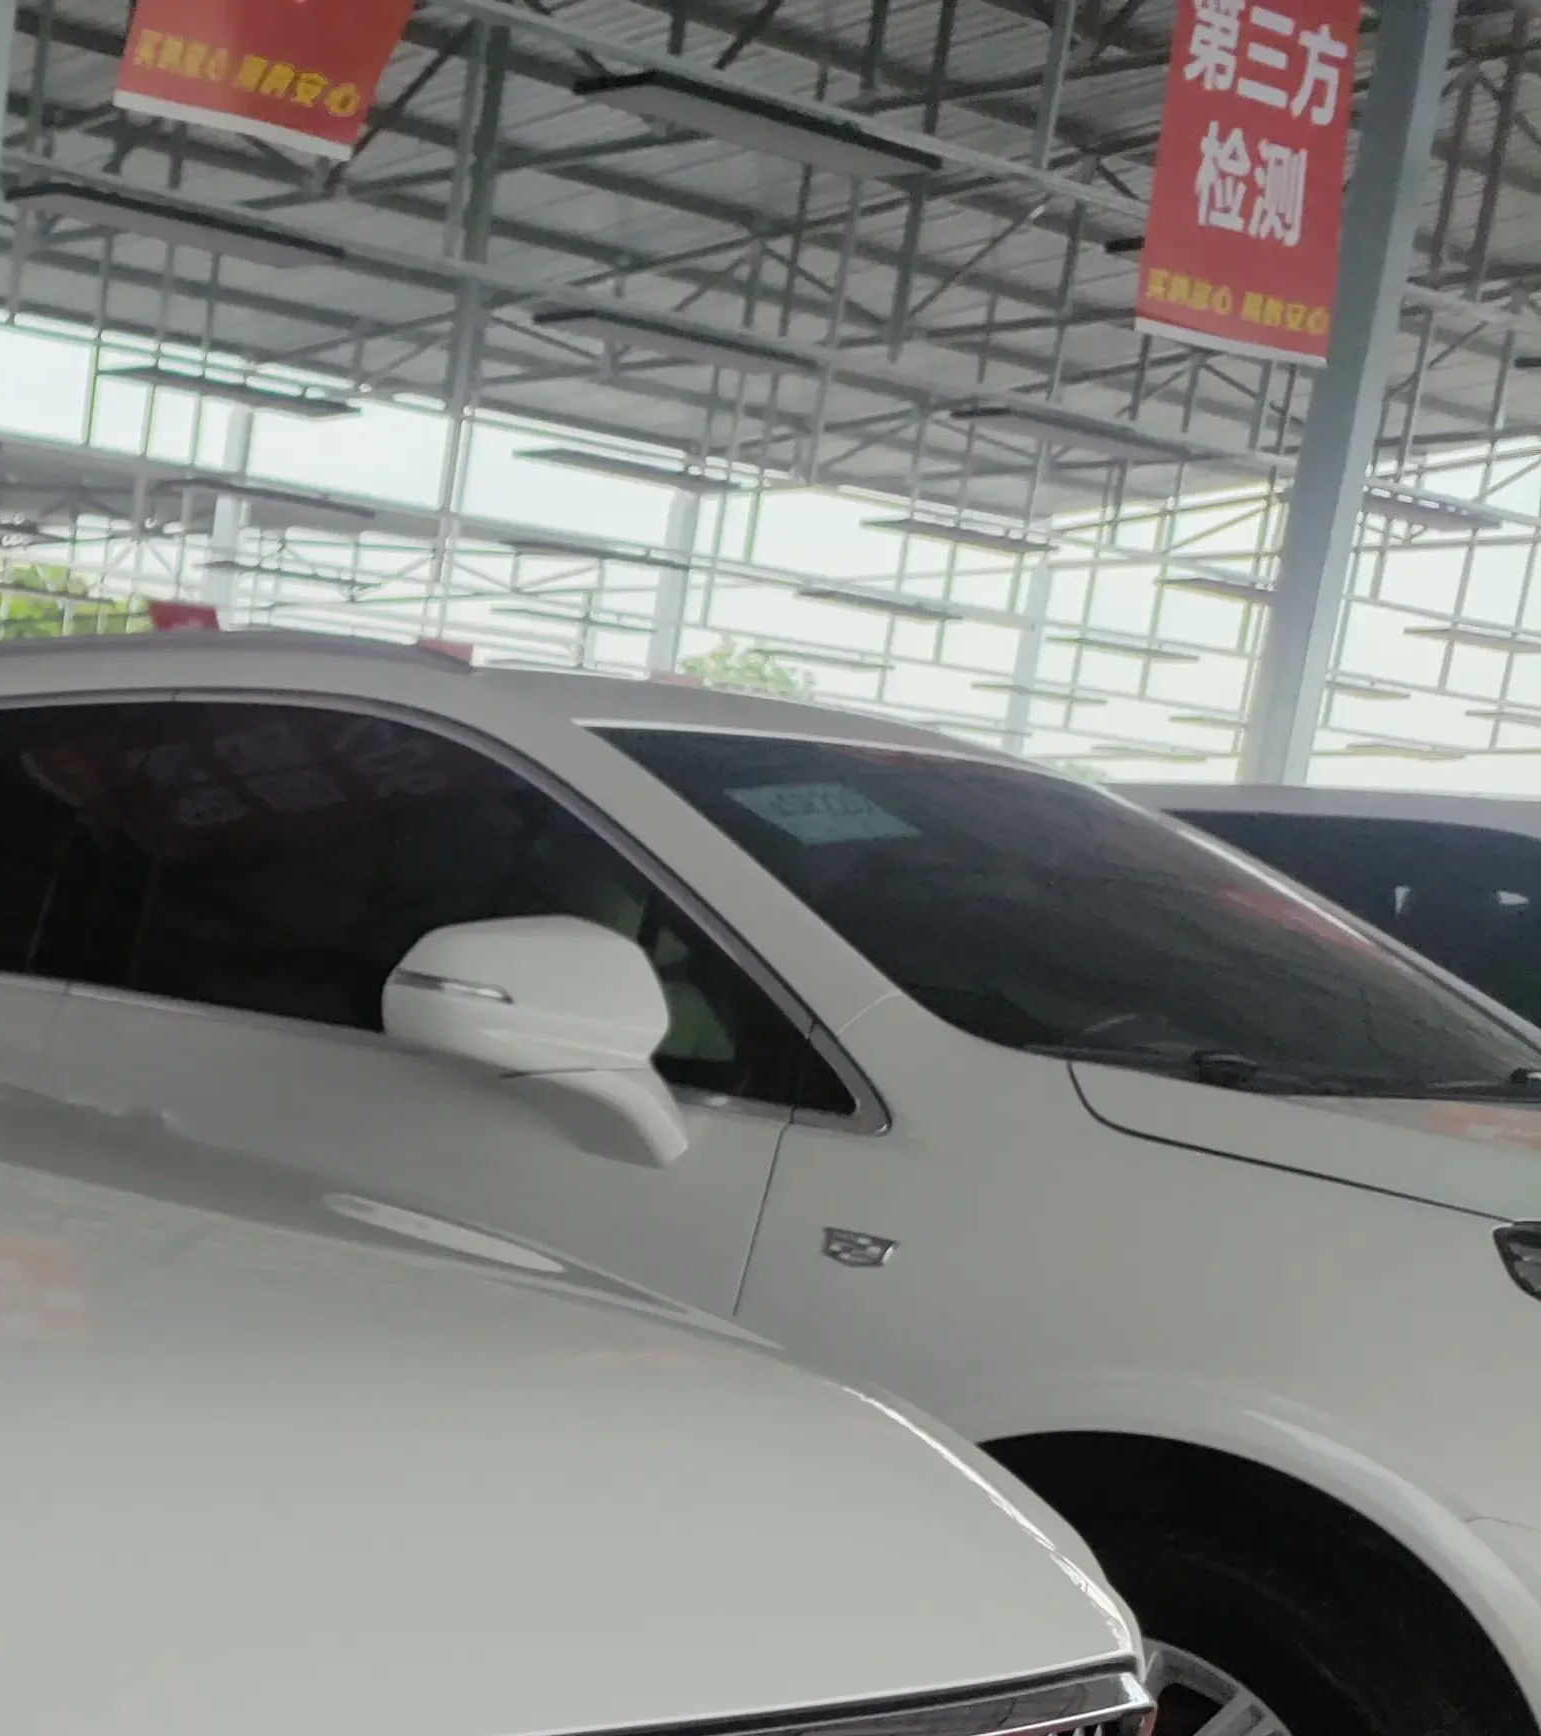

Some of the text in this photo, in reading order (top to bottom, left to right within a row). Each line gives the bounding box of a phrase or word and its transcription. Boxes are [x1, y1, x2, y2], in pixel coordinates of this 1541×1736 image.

[1184, 0, 1349, 126] 第三方
[1194, 120, 1308, 247] 检测
